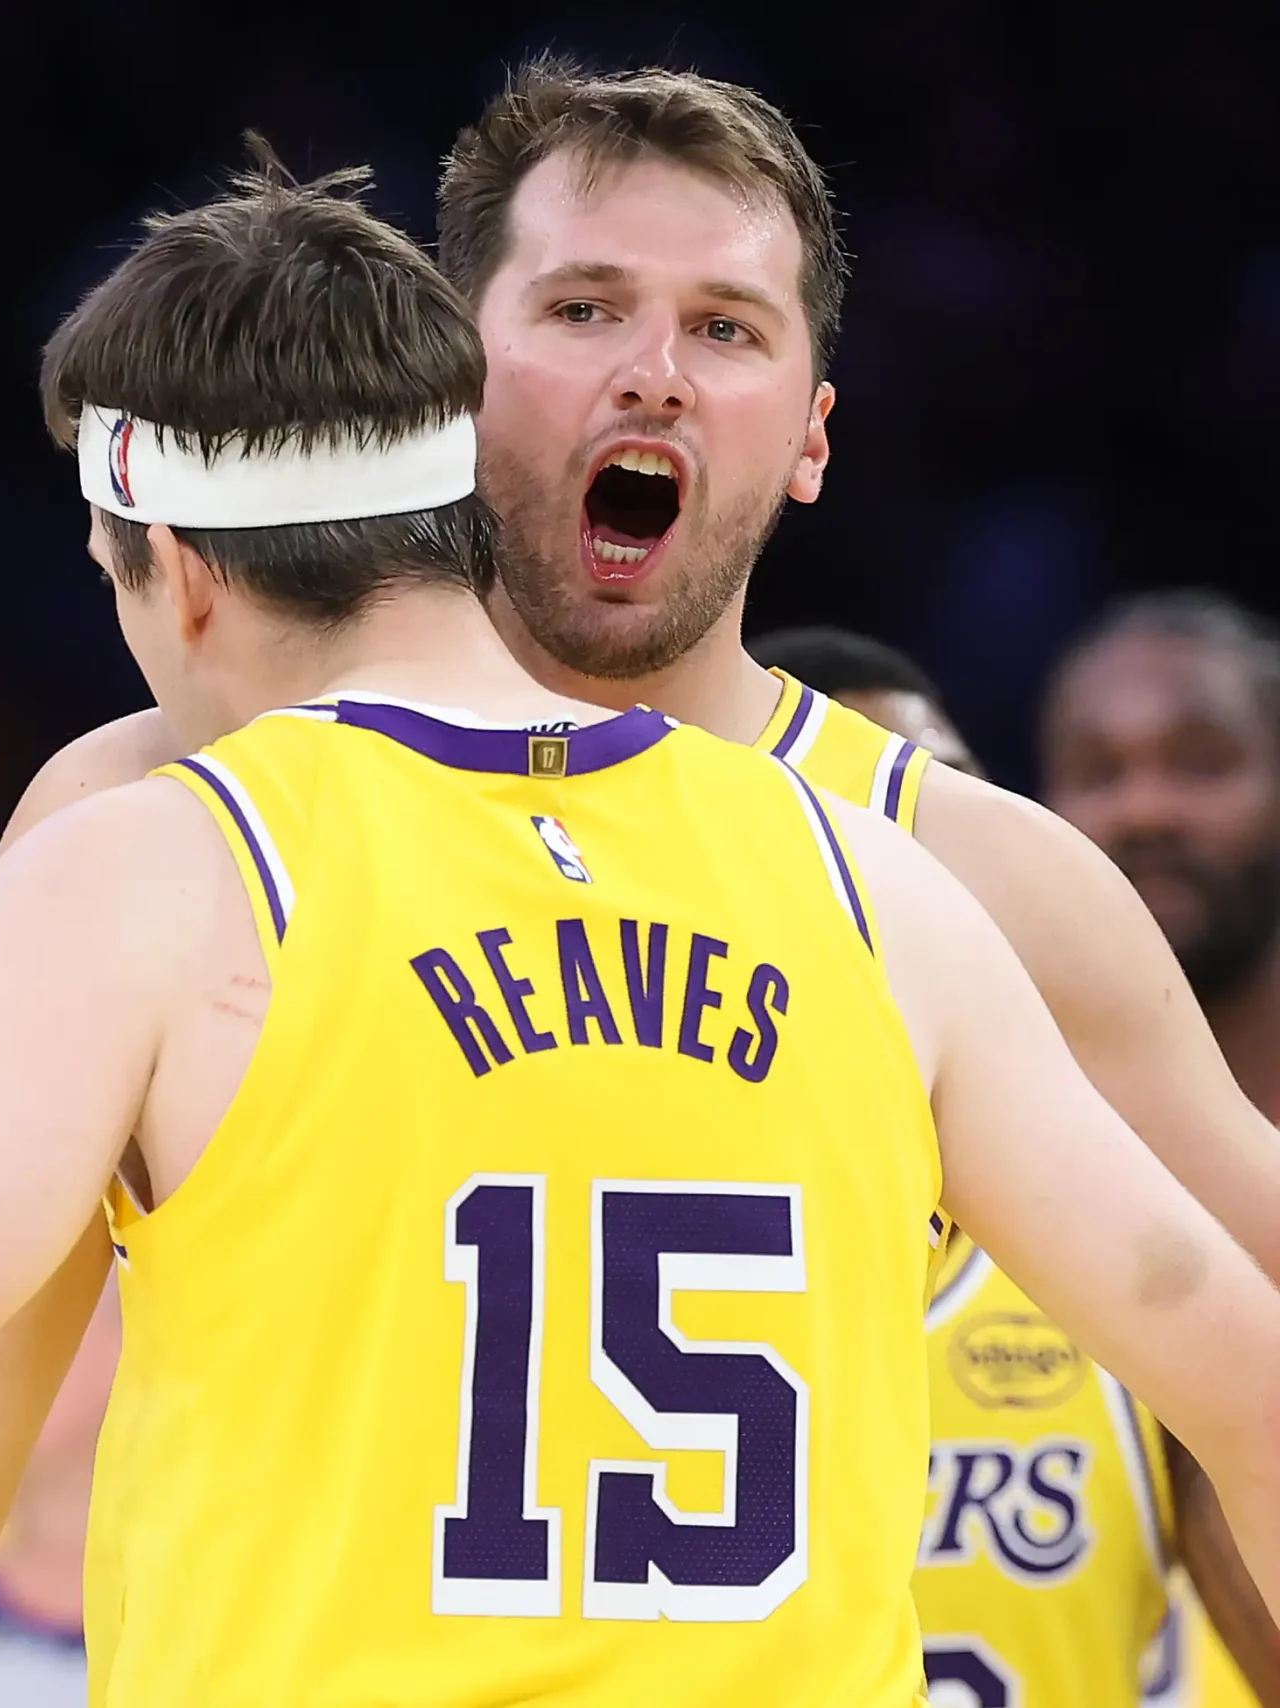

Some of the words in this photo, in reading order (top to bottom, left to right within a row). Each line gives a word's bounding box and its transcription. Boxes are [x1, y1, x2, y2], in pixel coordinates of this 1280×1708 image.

[542, 746, 556, 769] 17
[408, 917, 790, 1084] REAVES
[432, 1173, 809, 1622] 15
[926, 1444, 1089, 1576] RS
